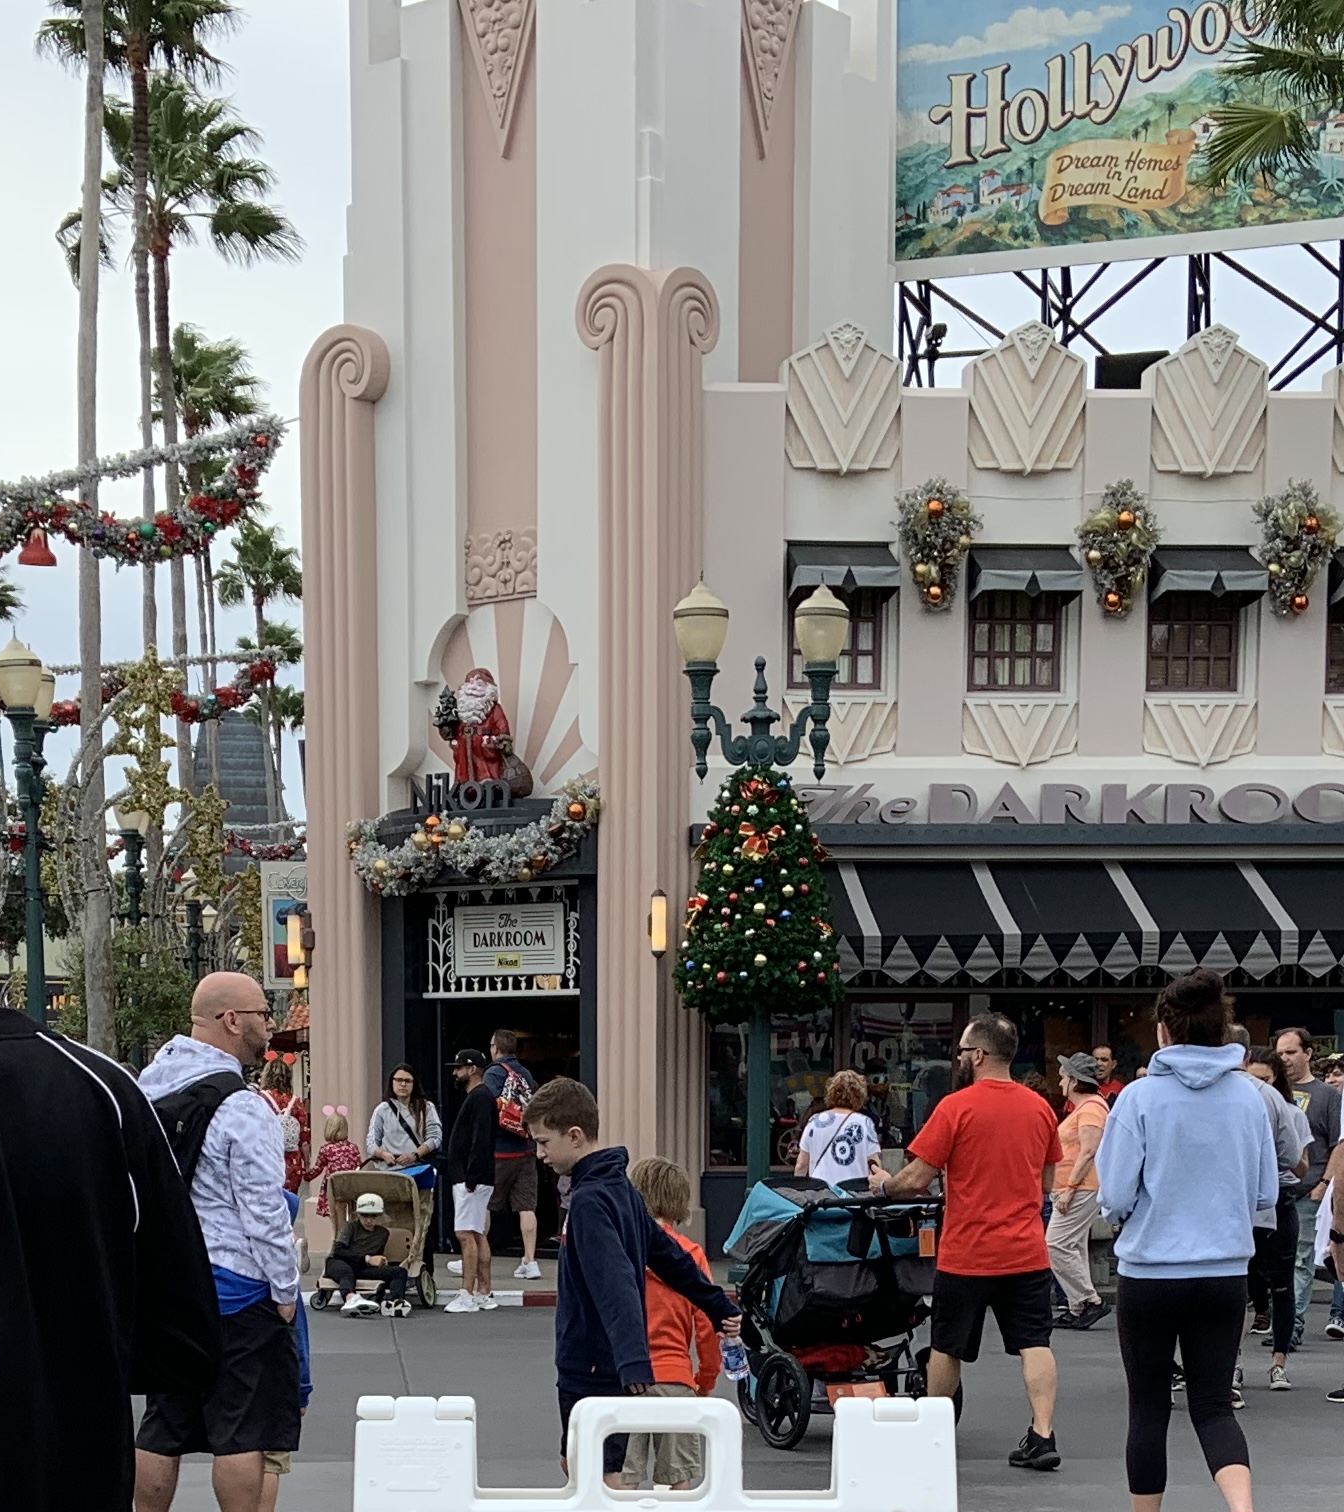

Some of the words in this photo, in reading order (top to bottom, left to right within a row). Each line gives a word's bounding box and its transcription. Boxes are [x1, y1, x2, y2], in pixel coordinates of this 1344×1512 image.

[929, 0, 1270, 169] Hollywoo
[1056, 154, 1119, 174] Dream
[1125, 148, 1183, 173] Homes
[1106, 167, 1122, 181] in
[1049, 181, 1111, 202] Dream
[1112, 175, 1171, 204] Land
[410, 771, 510, 815] Nikon
[791, 783, 918, 824] The
[498, 913, 518, 928] The
[472, 930, 546, 948] DARKROOM
[497, 957, 518, 967] Nikon
